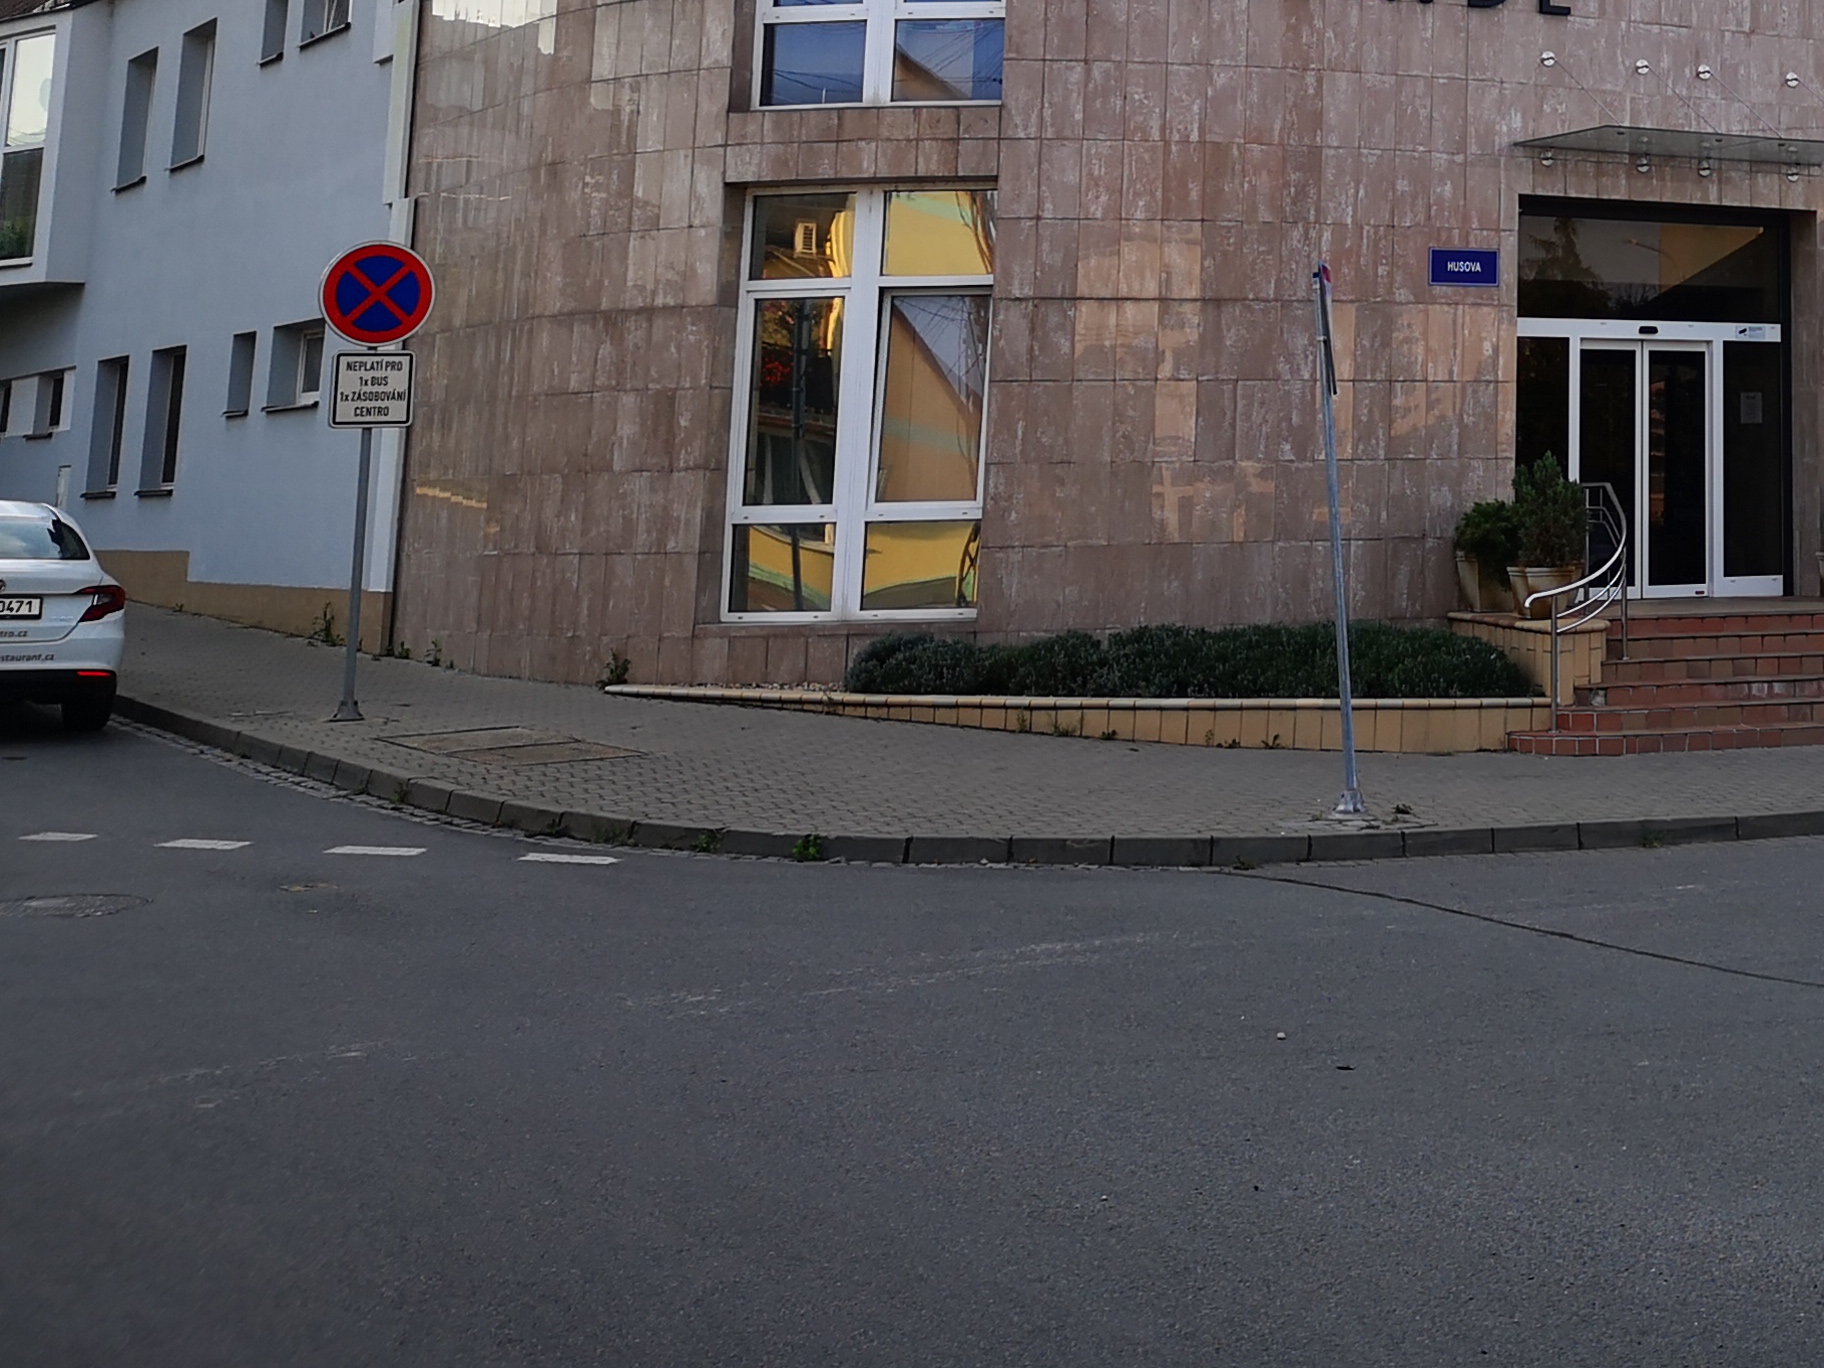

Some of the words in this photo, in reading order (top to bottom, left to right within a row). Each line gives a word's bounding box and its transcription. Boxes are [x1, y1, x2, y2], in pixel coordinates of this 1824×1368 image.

[1447, 261, 1482, 272] HUSOVA
[346, 358, 384, 371] NEPLATÍ
[385, 361, 403, 371] PRO
[359, 376, 369, 386] 1x
[371, 376, 388, 386] BUS
[340, 391, 349, 402] 1x
[351, 388, 406, 402] ZÁSOBOVÁNÍ
[354, 406, 389, 417] CENTRO
